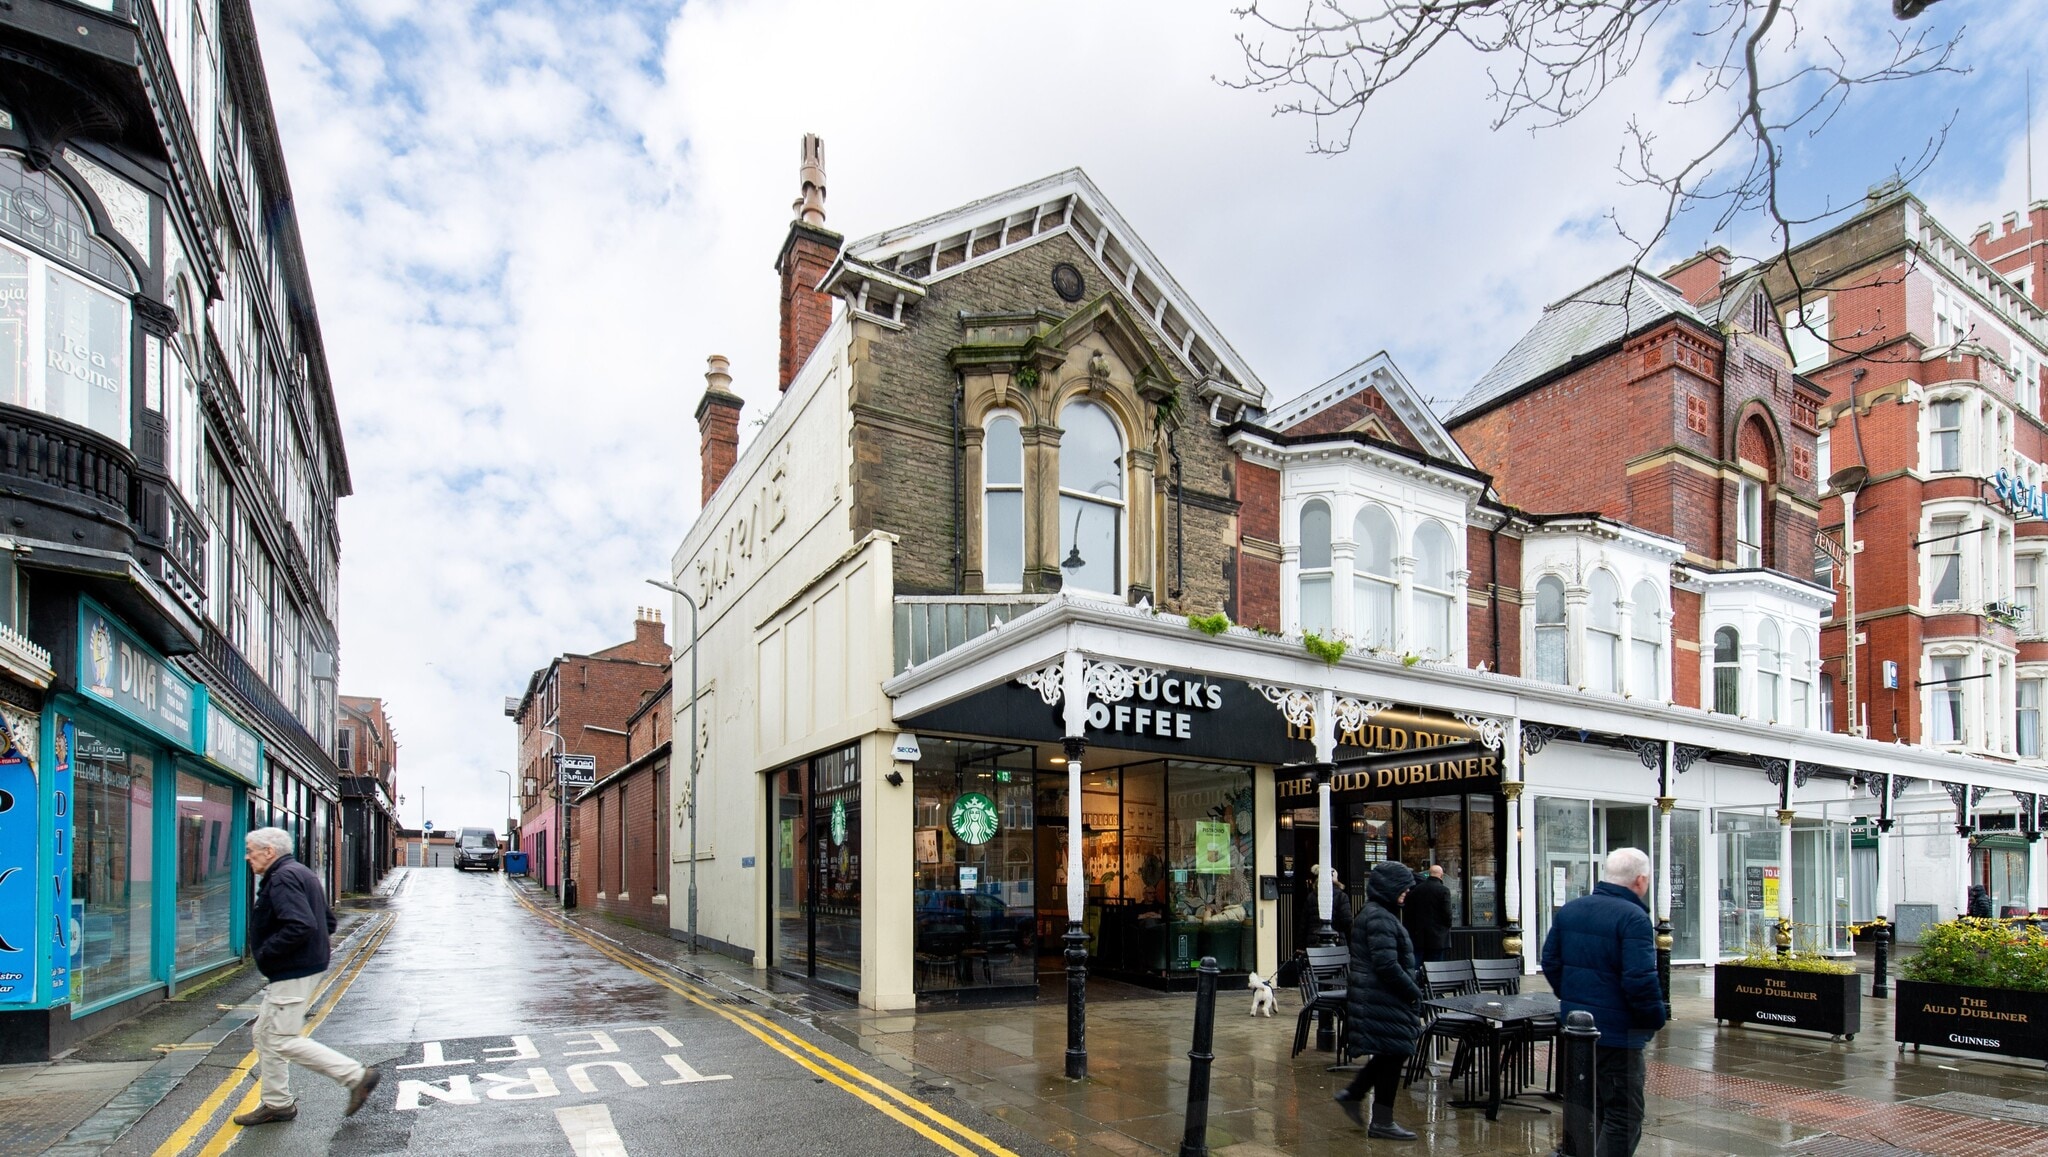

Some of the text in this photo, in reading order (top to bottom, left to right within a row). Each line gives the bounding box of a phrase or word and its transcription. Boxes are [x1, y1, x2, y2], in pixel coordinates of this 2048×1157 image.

[0, 287, 25, 308] gia
[60, 333, 105, 369] Tea
[47, 349, 118, 392] Rooms
[121, 641, 157, 712] DIVA
[218, 715, 237, 761] DIVA
[1088, 701, 1192, 739] OFFEE
[1277, 756, 1499, 798] THE ULD DUBLINER
[52, 789, 68, 949] DIVA
[1765, 869, 1773, 878] TO
[1735, 984, 1817, 1001] AULD DUBLINER
[1765, 978, 1786, 988] THE
[1756, 1010, 1797, 1023] GUINNESS
[1922, 1003, 2028, 1023] AULD DUBLINER
[1960, 996, 1988, 1008] THE
[396, 1026, 684, 1069] LEFT
[1949, 1033, 2000, 1048] GUINNESS
[395, 1054, 734, 1110] TURN
